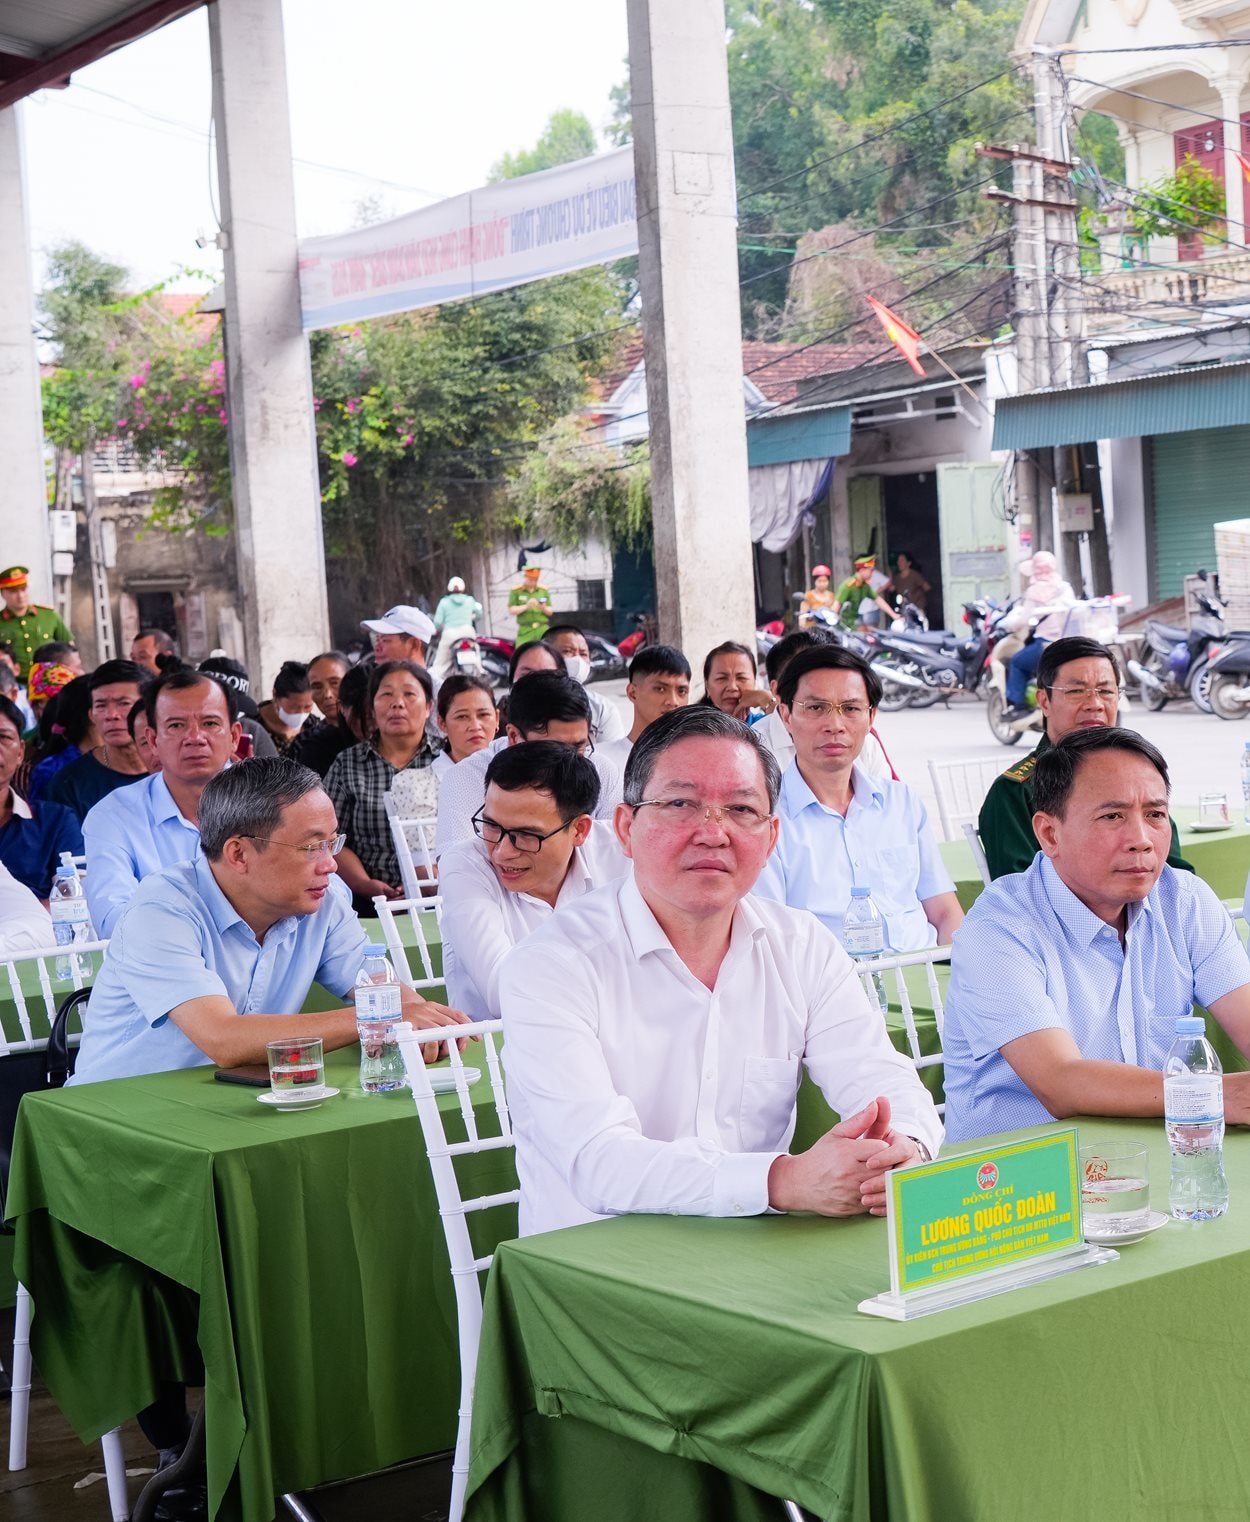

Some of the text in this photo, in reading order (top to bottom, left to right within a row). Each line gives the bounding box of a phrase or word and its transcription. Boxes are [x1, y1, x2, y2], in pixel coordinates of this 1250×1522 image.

[962, 1185, 1014, 1206] ĐỒNG CHÍ
[920, 1213, 970, 1246] LƯƠNG
[974, 1197, 1013, 1233] QUỐC
[1016, 1190, 1056, 1221] ĐOÀN
[940, 1243, 957, 1255] TRUNG
[1060, 1212, 1072, 1223] NAM
[1037, 1233, 1049, 1244] NAM
